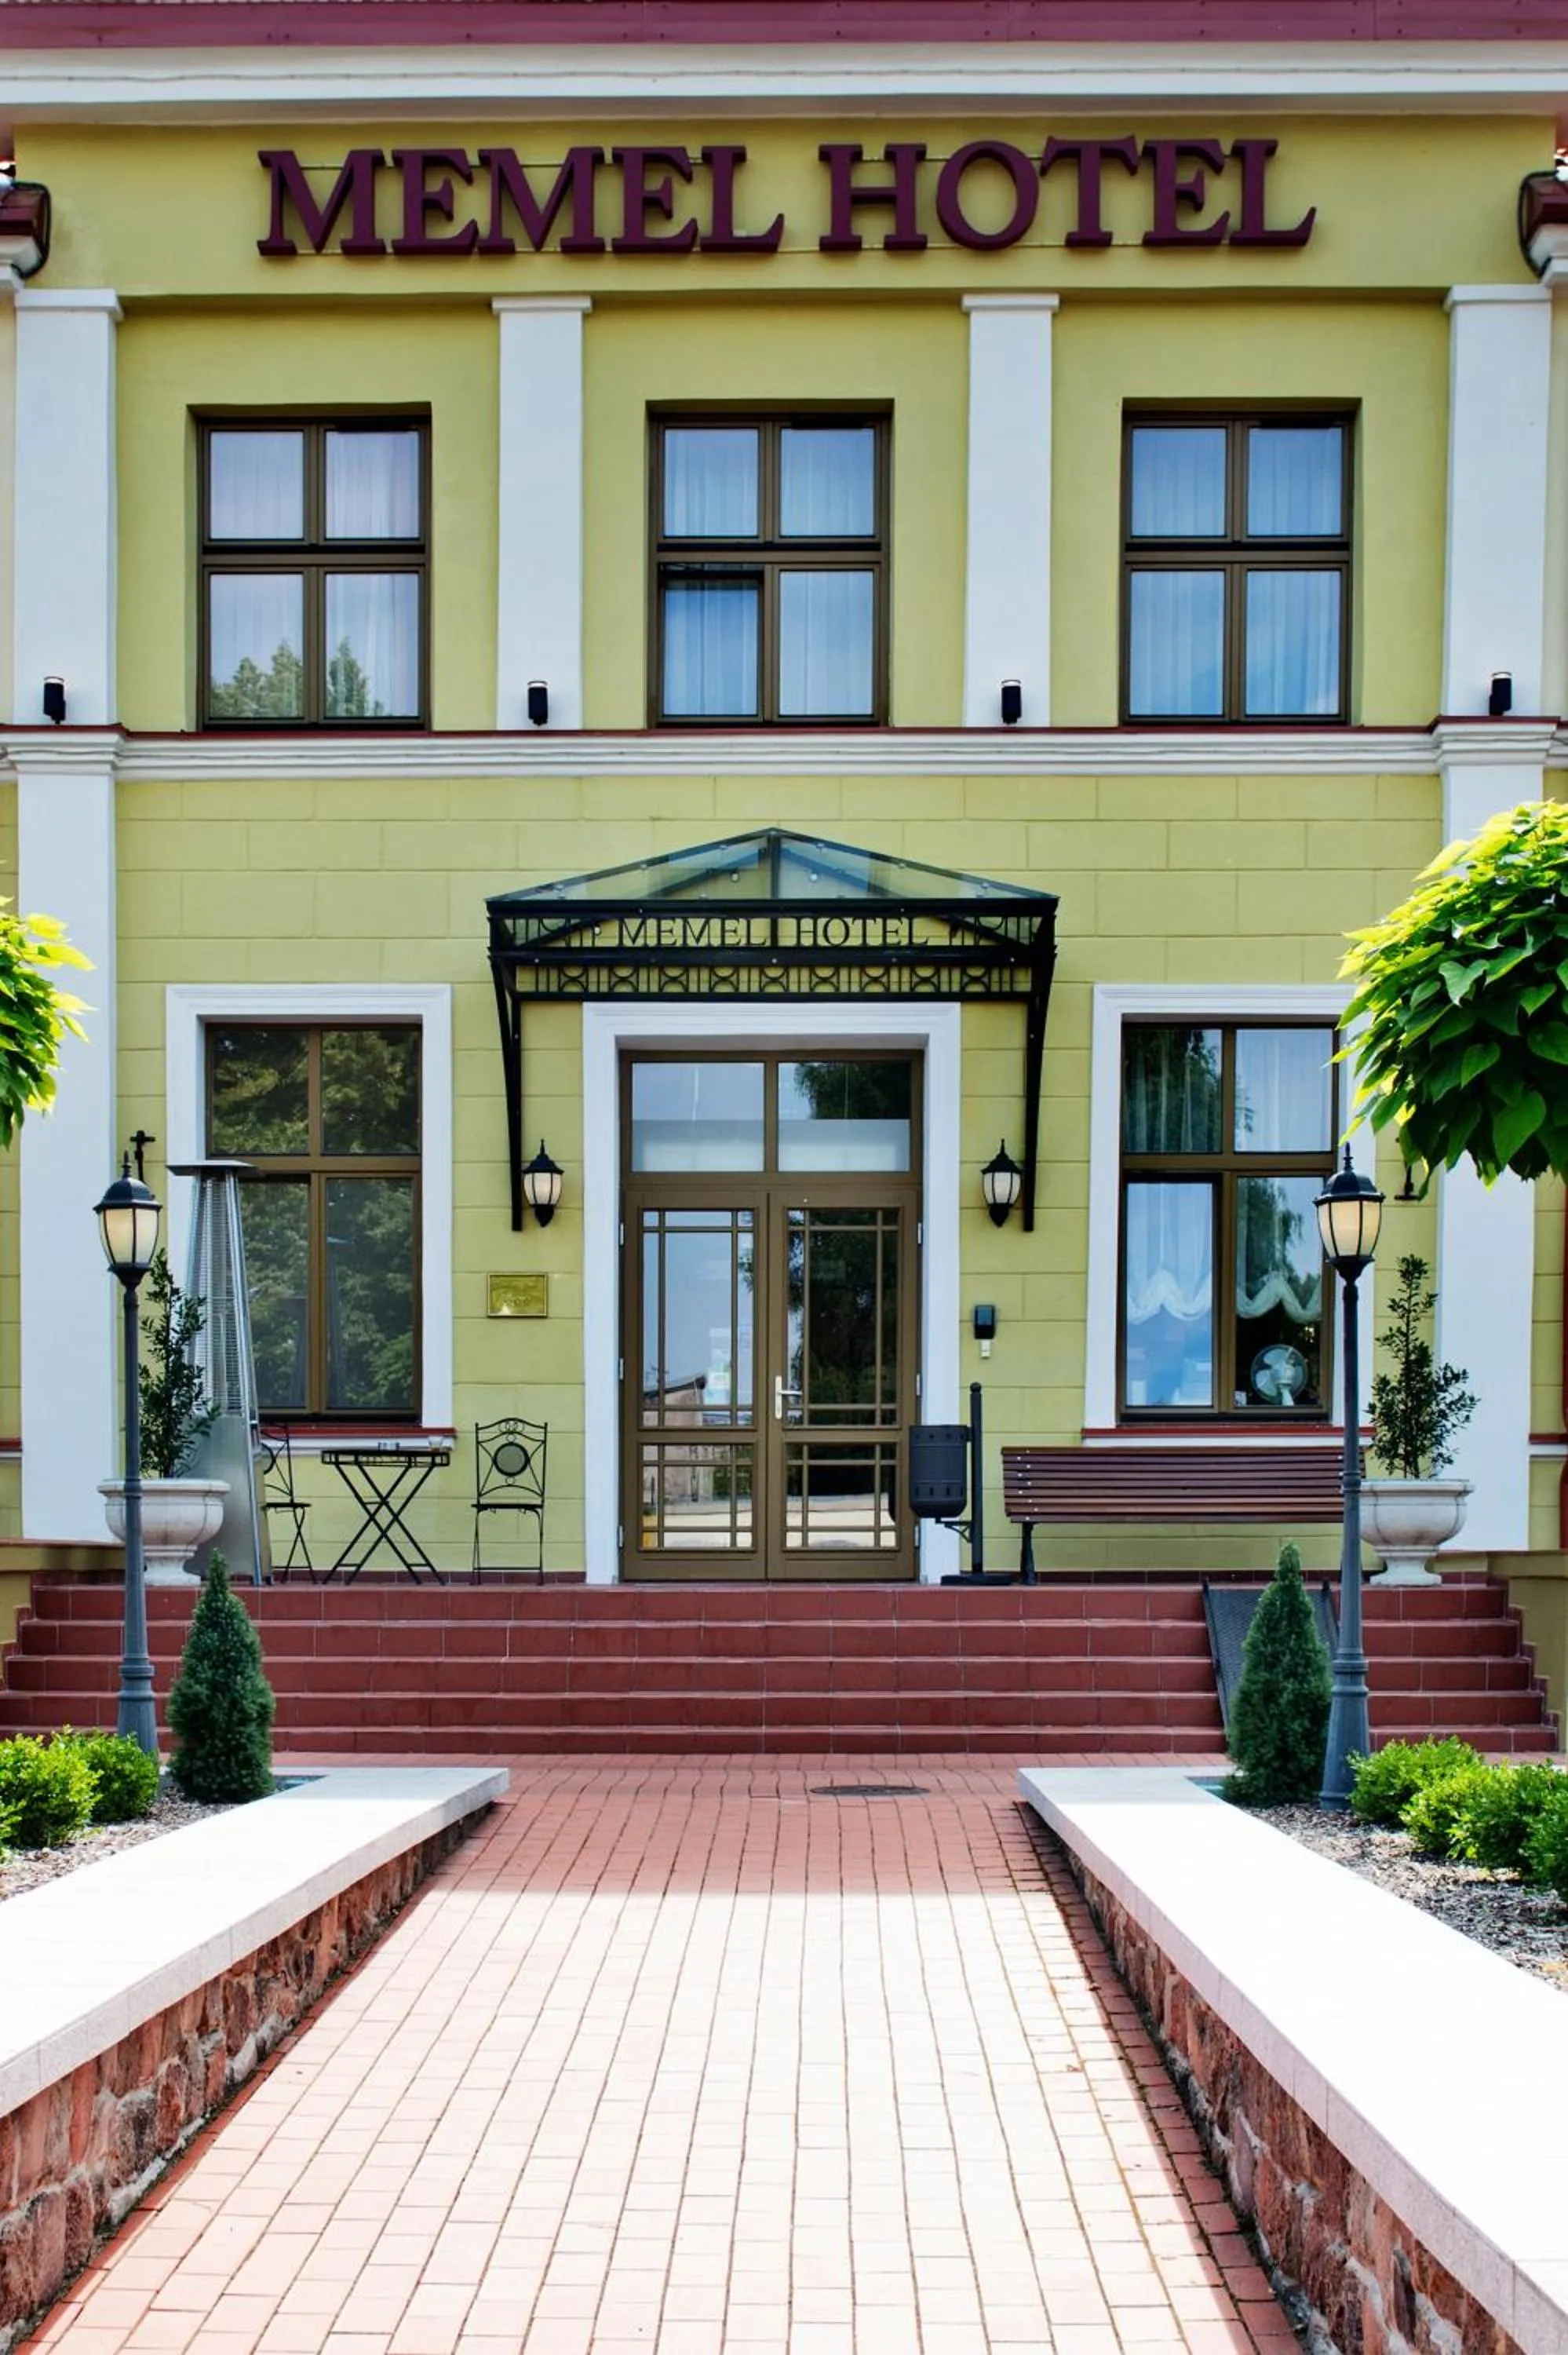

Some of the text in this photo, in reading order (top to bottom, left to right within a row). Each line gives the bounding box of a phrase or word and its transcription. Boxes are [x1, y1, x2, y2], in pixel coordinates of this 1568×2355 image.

[257, 134, 1316, 256] MEMEL HOTEL
[618, 916, 929, 947] MEMEL HOTEL
